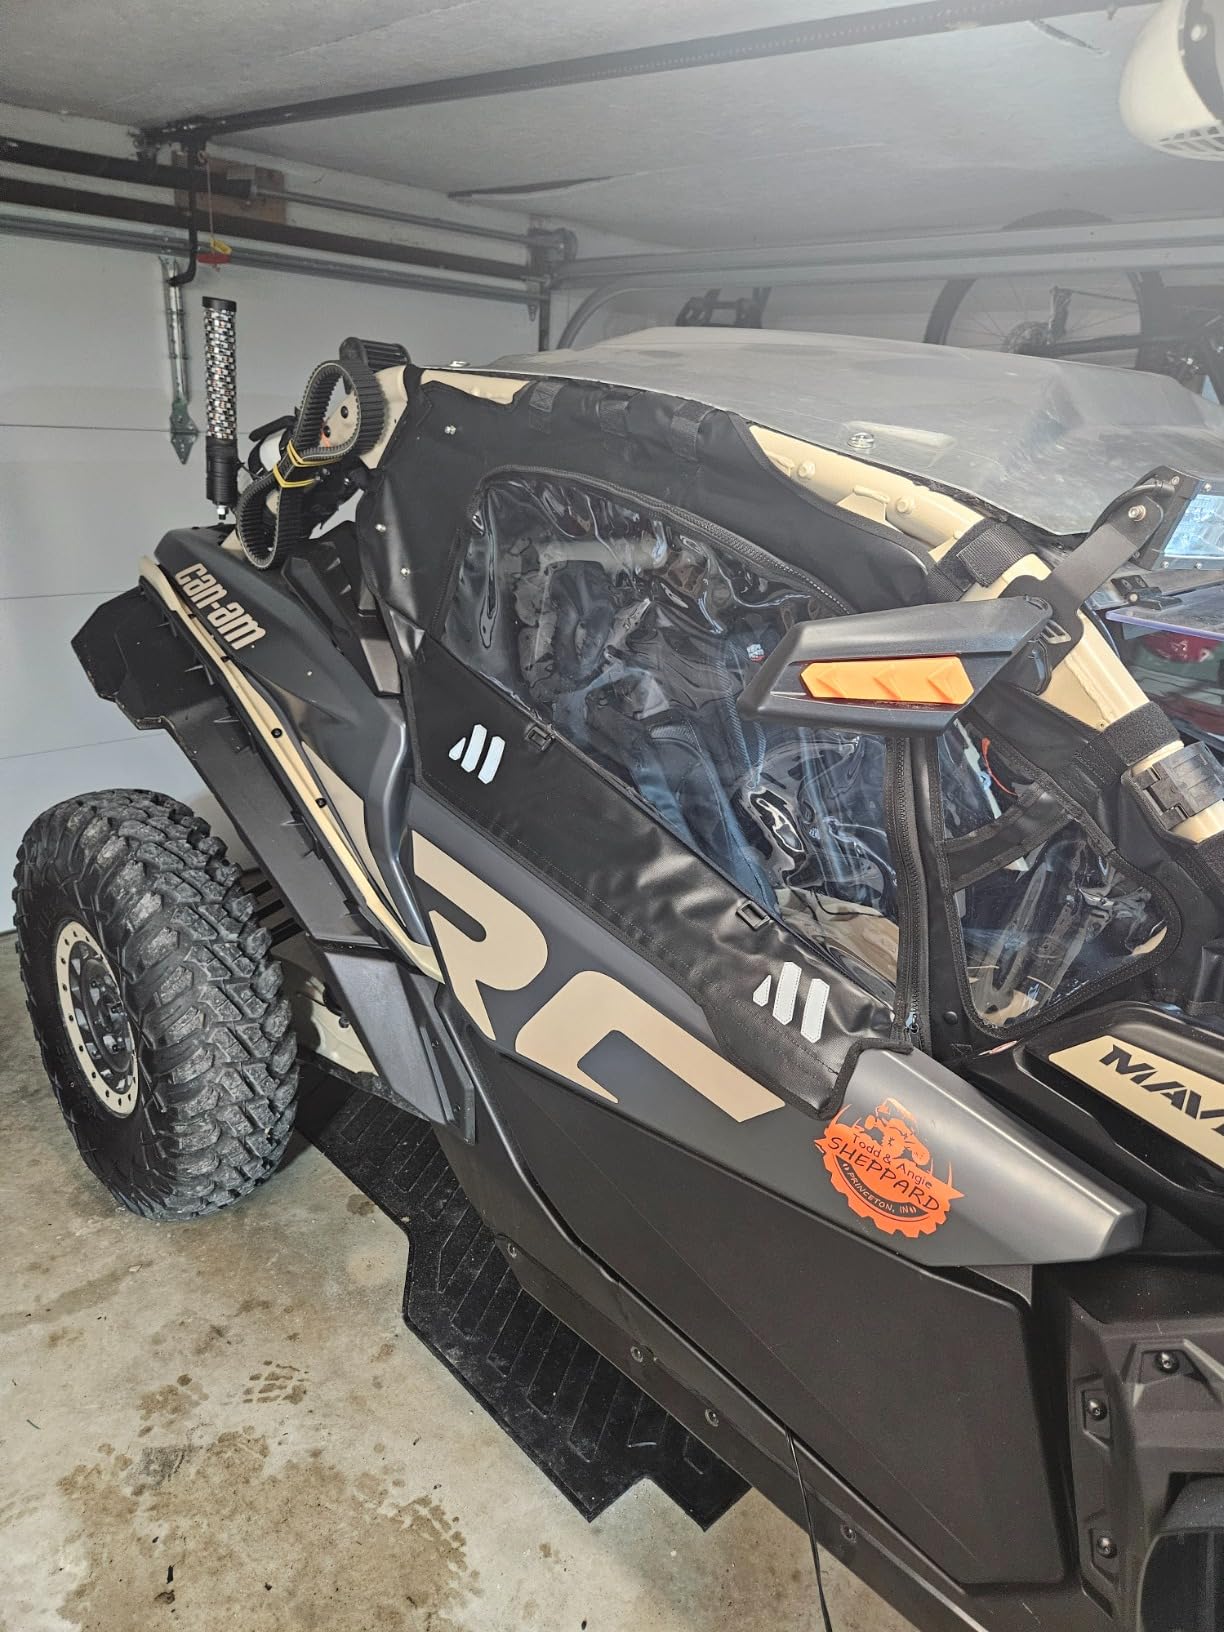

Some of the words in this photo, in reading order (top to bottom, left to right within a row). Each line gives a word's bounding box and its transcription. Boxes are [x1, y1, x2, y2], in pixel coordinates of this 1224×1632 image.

[175, 563, 266, 650] can-am
[1099, 1044, 1224, 1137] MAV
[827, 1137, 940, 1211] SHEPPARD
[847, 1172, 895, 1213] PRINCETON,
[852, 1133, 881, 1158] Todd
[882, 1153, 892, 1165] &
[896, 1163, 933, 1189] Angie
